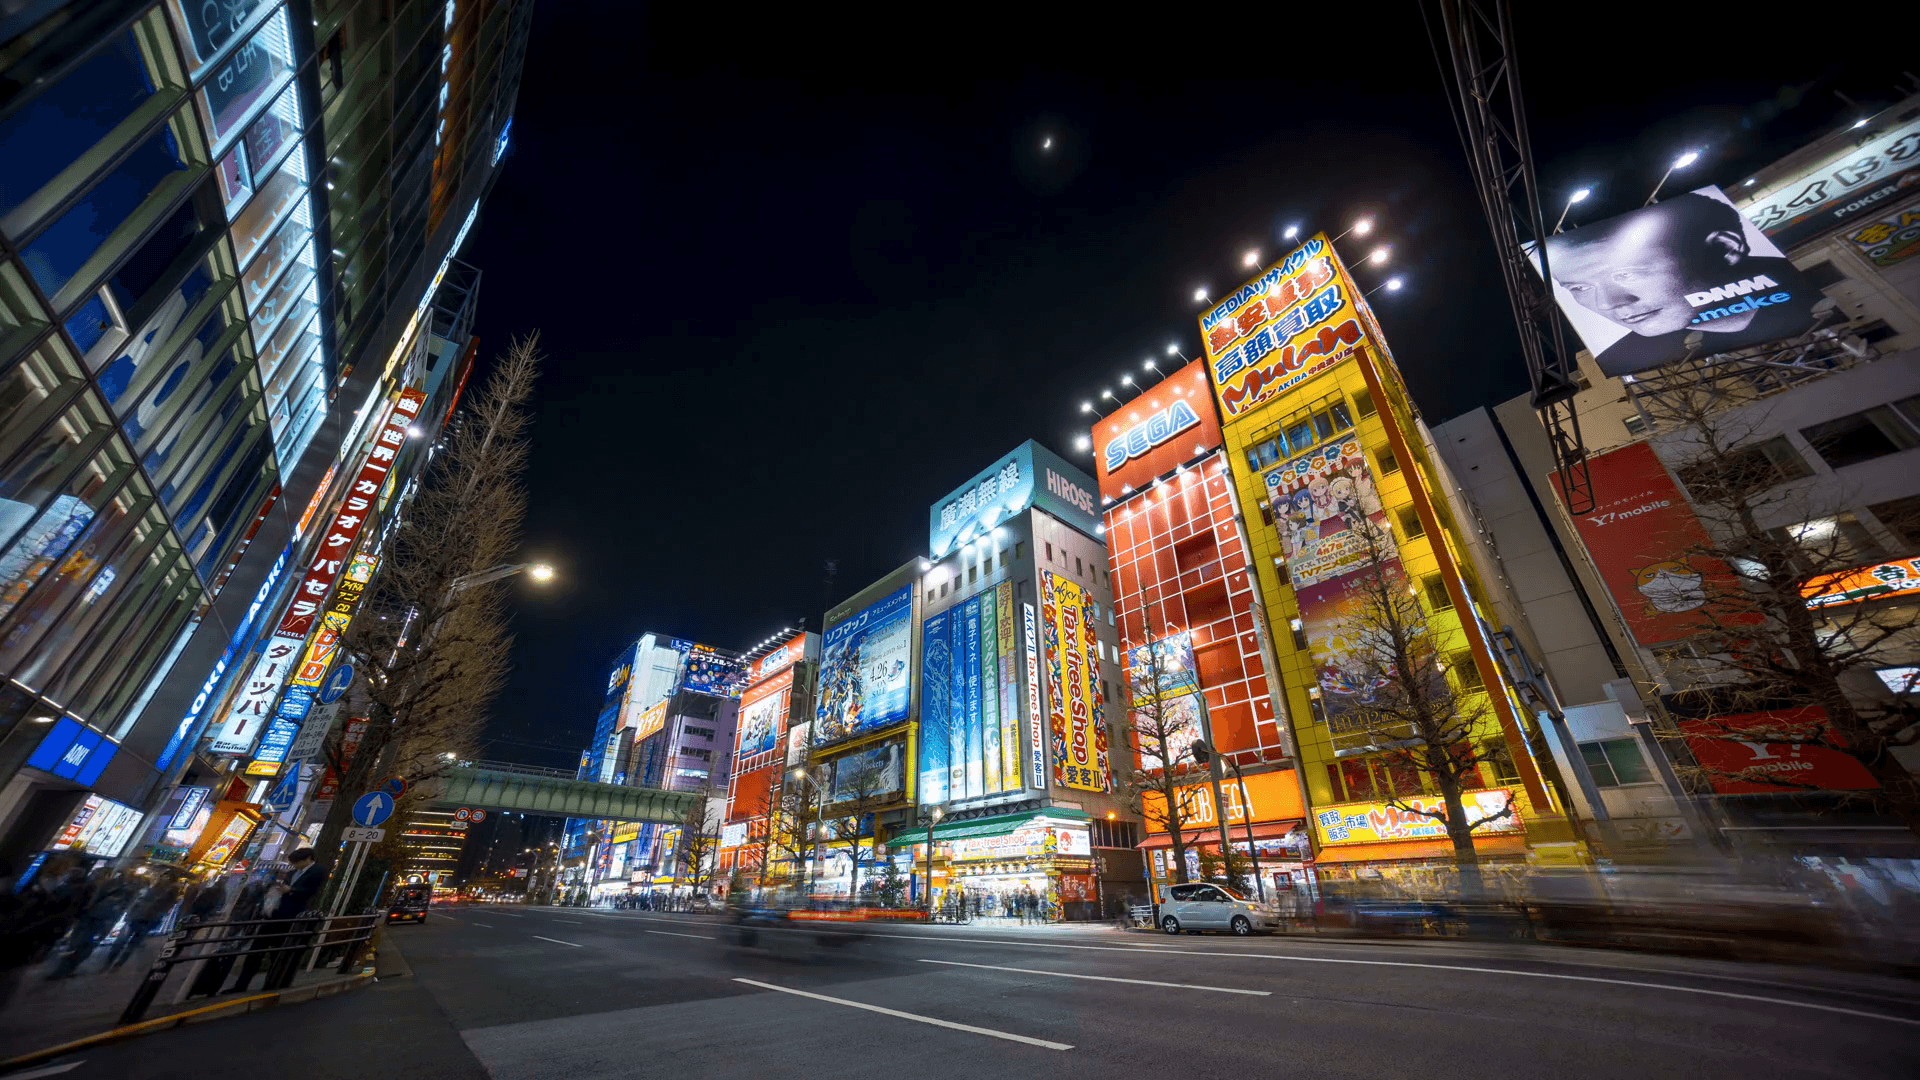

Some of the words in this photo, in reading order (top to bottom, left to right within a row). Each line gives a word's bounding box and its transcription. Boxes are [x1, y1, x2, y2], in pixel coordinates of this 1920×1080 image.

[1683, 274, 1779, 308] DMM
[1214, 284, 1343, 385] 高額買取
[1277, 372, 1308, 393] AKIBA
[1105, 398, 1201, 475] SEGA
[1046, 467, 1095, 517] HIROSE
[249, 554, 285, 625] AOKI
[826, 610, 870, 644] ソフマップ
[297, 628, 340, 682] DVD
[179, 659, 226, 741] AOKI
[234, 643, 296, 736] ダーツバー
[1219, 780, 1256, 820] EGA
